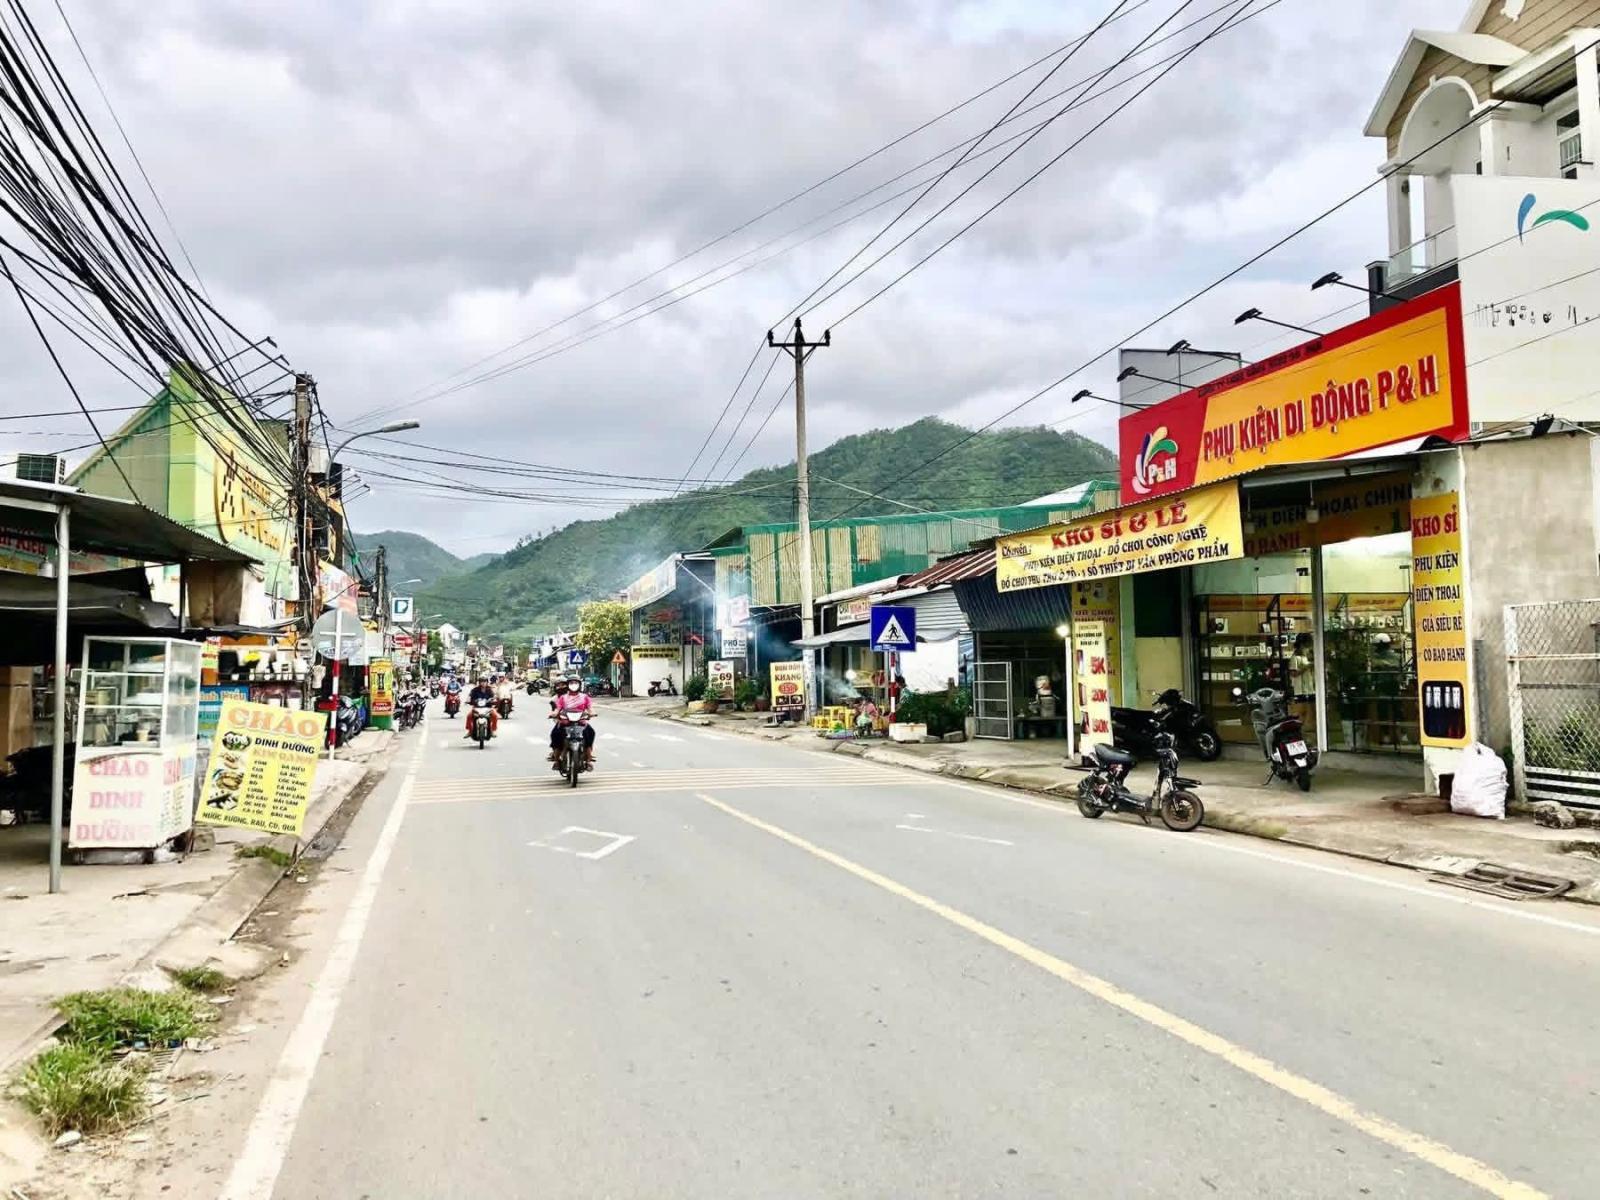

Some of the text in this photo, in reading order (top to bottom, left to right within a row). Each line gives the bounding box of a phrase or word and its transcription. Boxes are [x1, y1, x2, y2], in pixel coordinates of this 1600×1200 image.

[1204, 424, 1235, 464] PHỤ
[1239, 405, 1281, 453] KIỆN
[1284, 400, 1306, 437] DI
[1311, 379, 1372, 434] ĐỘNG
[1051, 499, 1188, 550] KHO SỈ & LẺ
[1413, 504, 1458, 538] KHO SỈ
[1146, 533, 1174, 548] CÔNG
[1176, 523, 1207, 542] NGHỆ
[1158, 548, 1194, 566] PHÒNG
[1197, 537, 1229, 560] PHẨM
[1415, 550, 1458, 574] PHỤ KIỆN
[1416, 584, 1460, 605] ĐIỆN THOẠI
[1423, 613, 1435, 632] GIÁ
[1436, 613, 1452, 632] SIÊU
[255, 737, 278, 748] DINH
